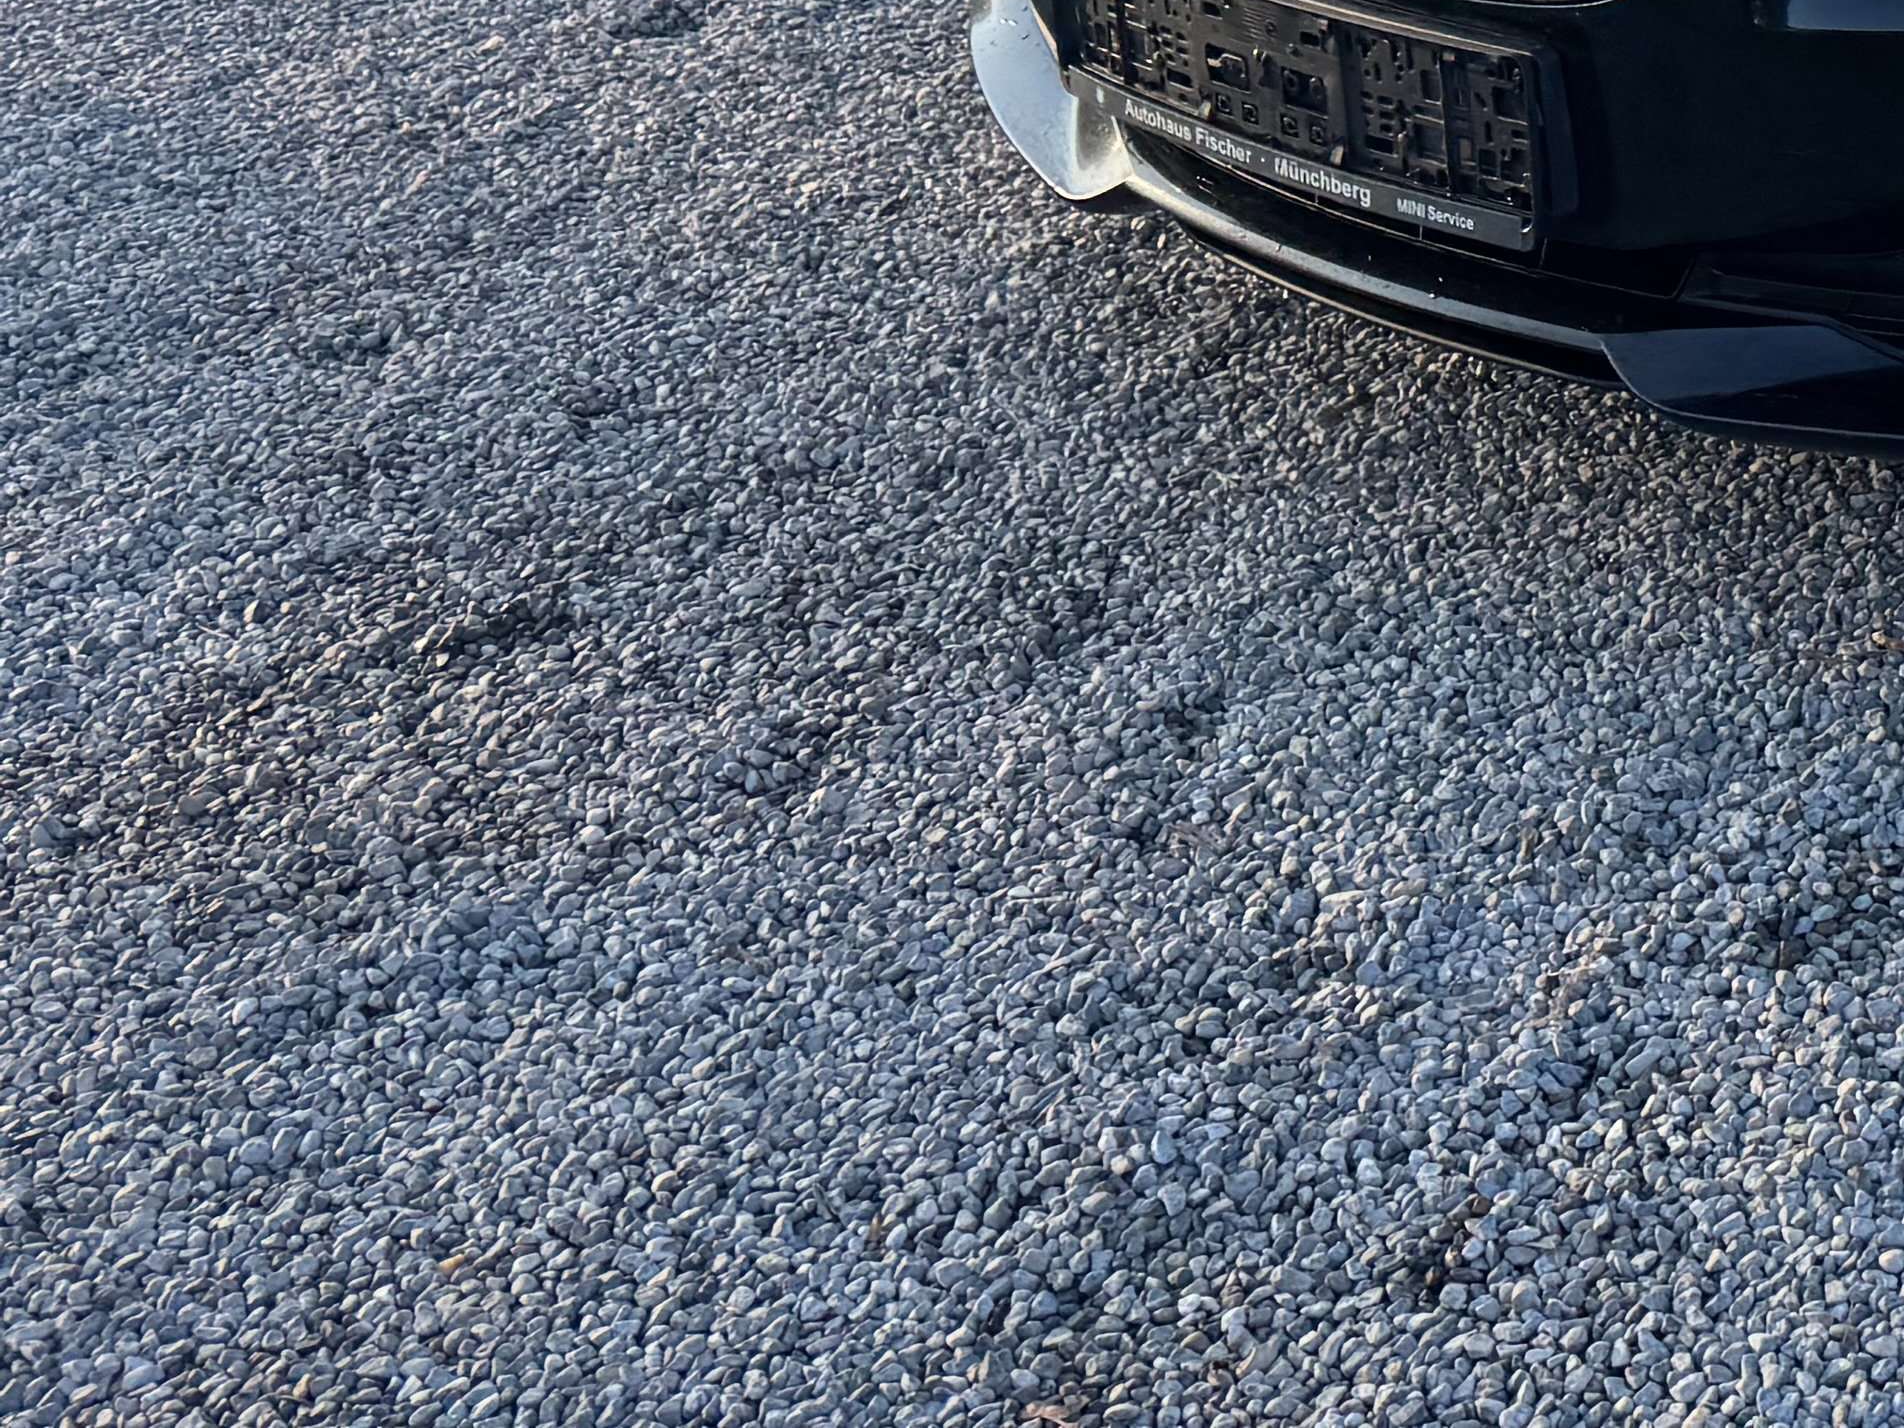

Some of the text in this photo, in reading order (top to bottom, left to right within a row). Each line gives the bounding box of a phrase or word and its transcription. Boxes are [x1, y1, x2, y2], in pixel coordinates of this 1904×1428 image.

[1124, 99, 1371, 208] Autohaus Fischer Münchberg
[1396, 196, 1475, 232] MINI Service
